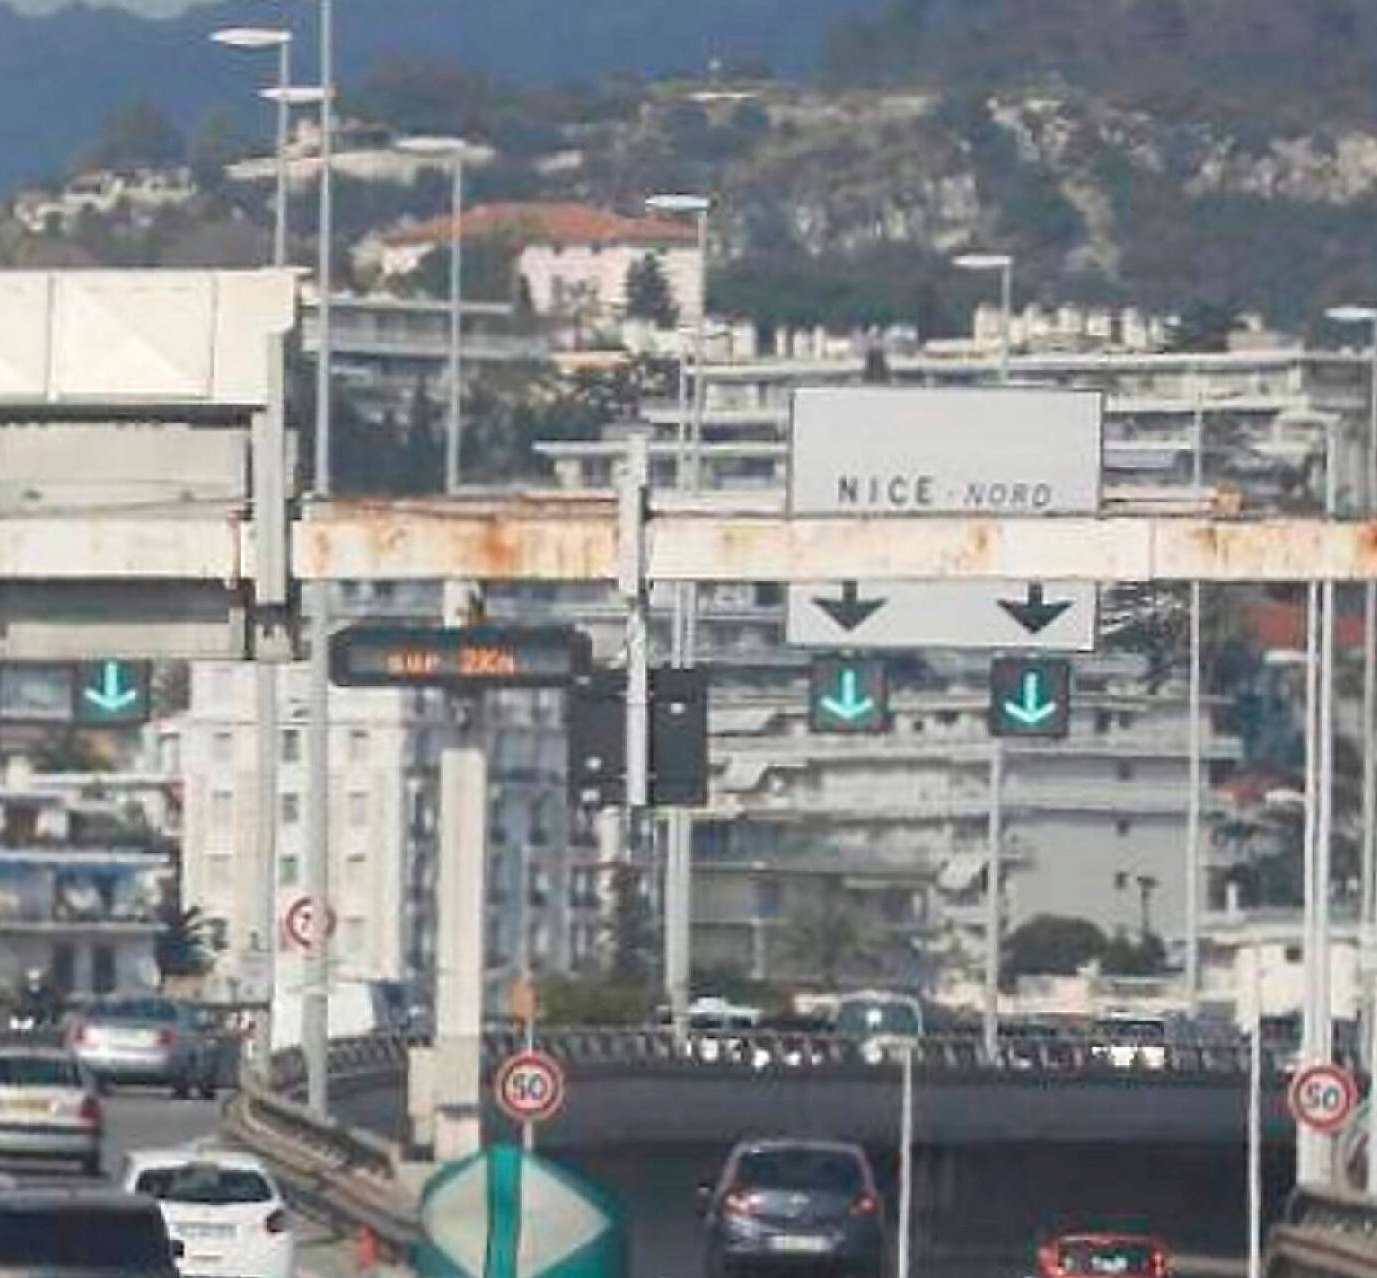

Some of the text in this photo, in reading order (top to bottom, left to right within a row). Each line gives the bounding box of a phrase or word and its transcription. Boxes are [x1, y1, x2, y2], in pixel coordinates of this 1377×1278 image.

[836, 473, 935, 507] NICE
[963, 481, 1053, 508] NORD
[1305, 1081, 1340, 1111] 50
